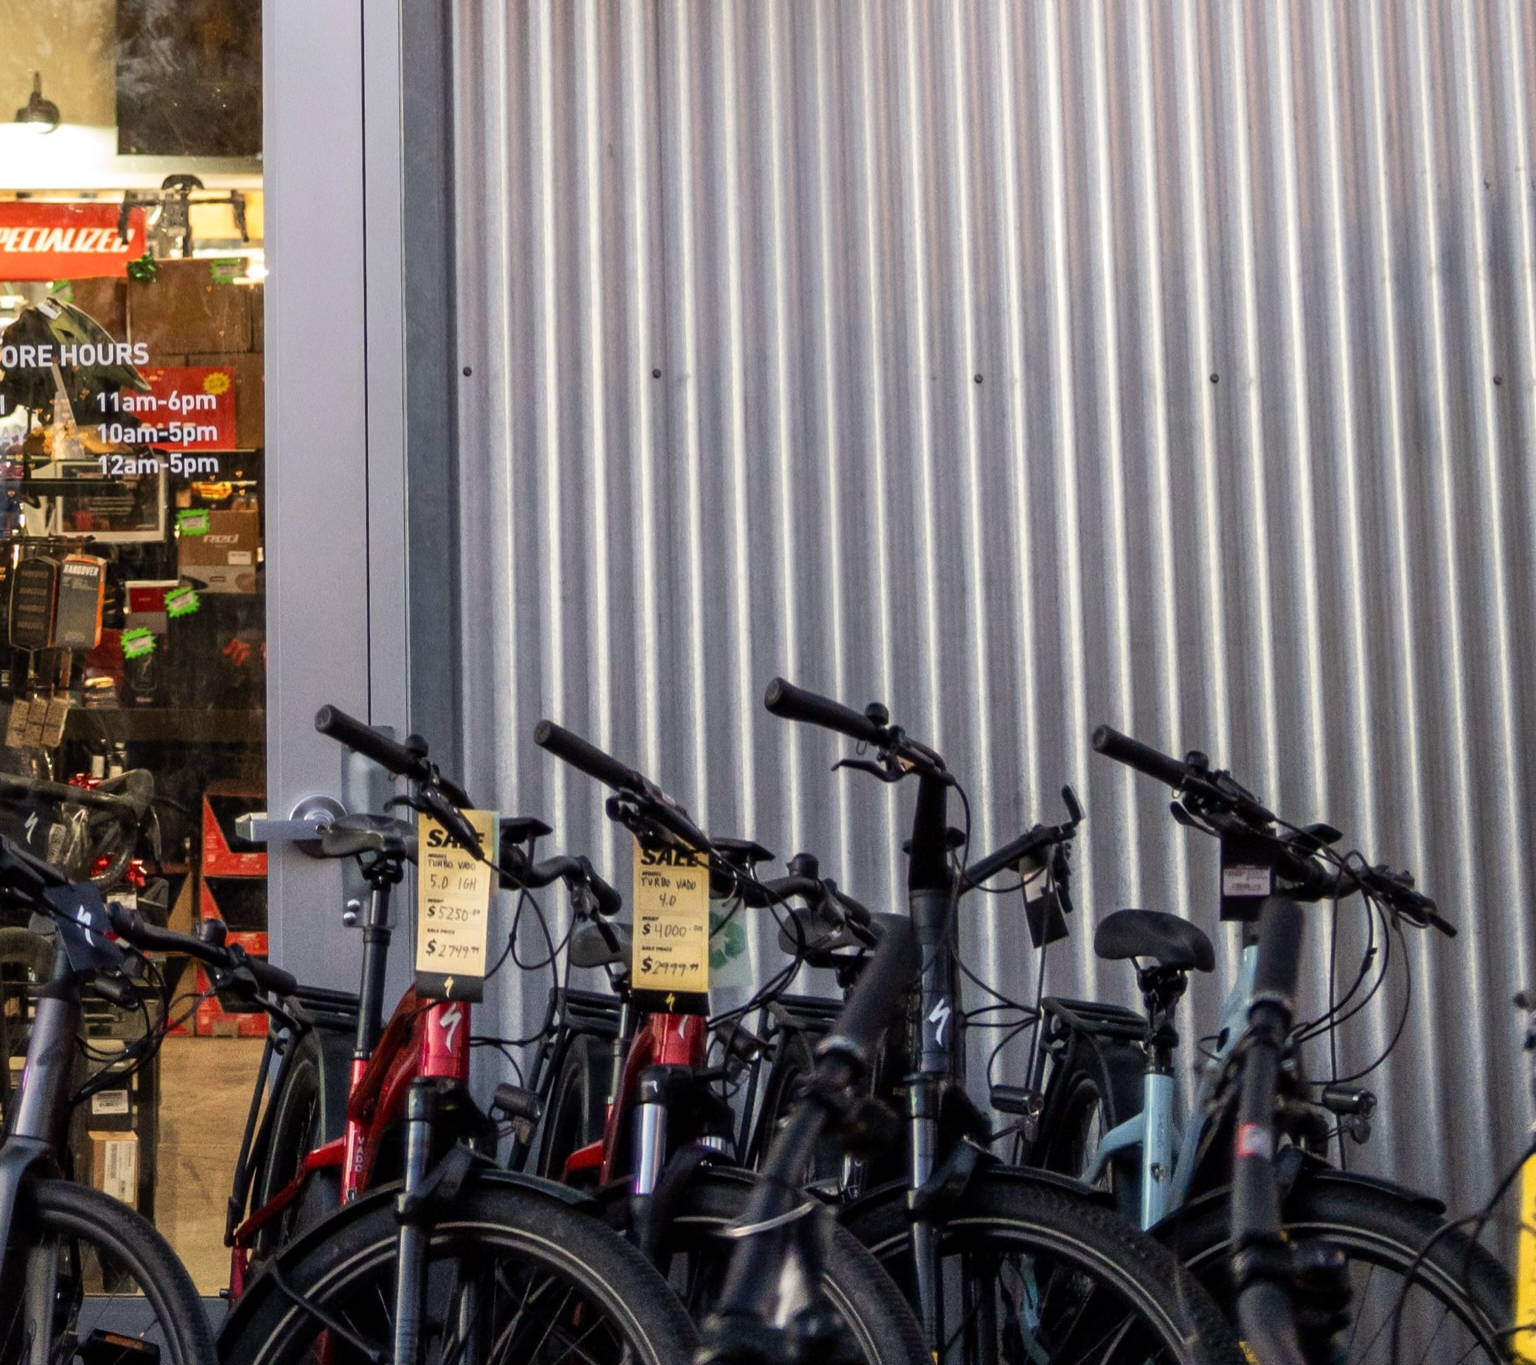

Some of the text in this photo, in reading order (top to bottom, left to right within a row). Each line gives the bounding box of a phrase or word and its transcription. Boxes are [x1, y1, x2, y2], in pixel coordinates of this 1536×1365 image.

[61, 342, 149, 367] HOURS
[97, 391, 216, 415] 11am-6pm
[97, 422, 217, 447] 10am-5pm
[99, 454, 219, 478] 12am-5pm
[426, 829, 485, 849] SAE
[430, 874, 449, 889] 5.0
[354, 1136, 364, 1172] VADO
